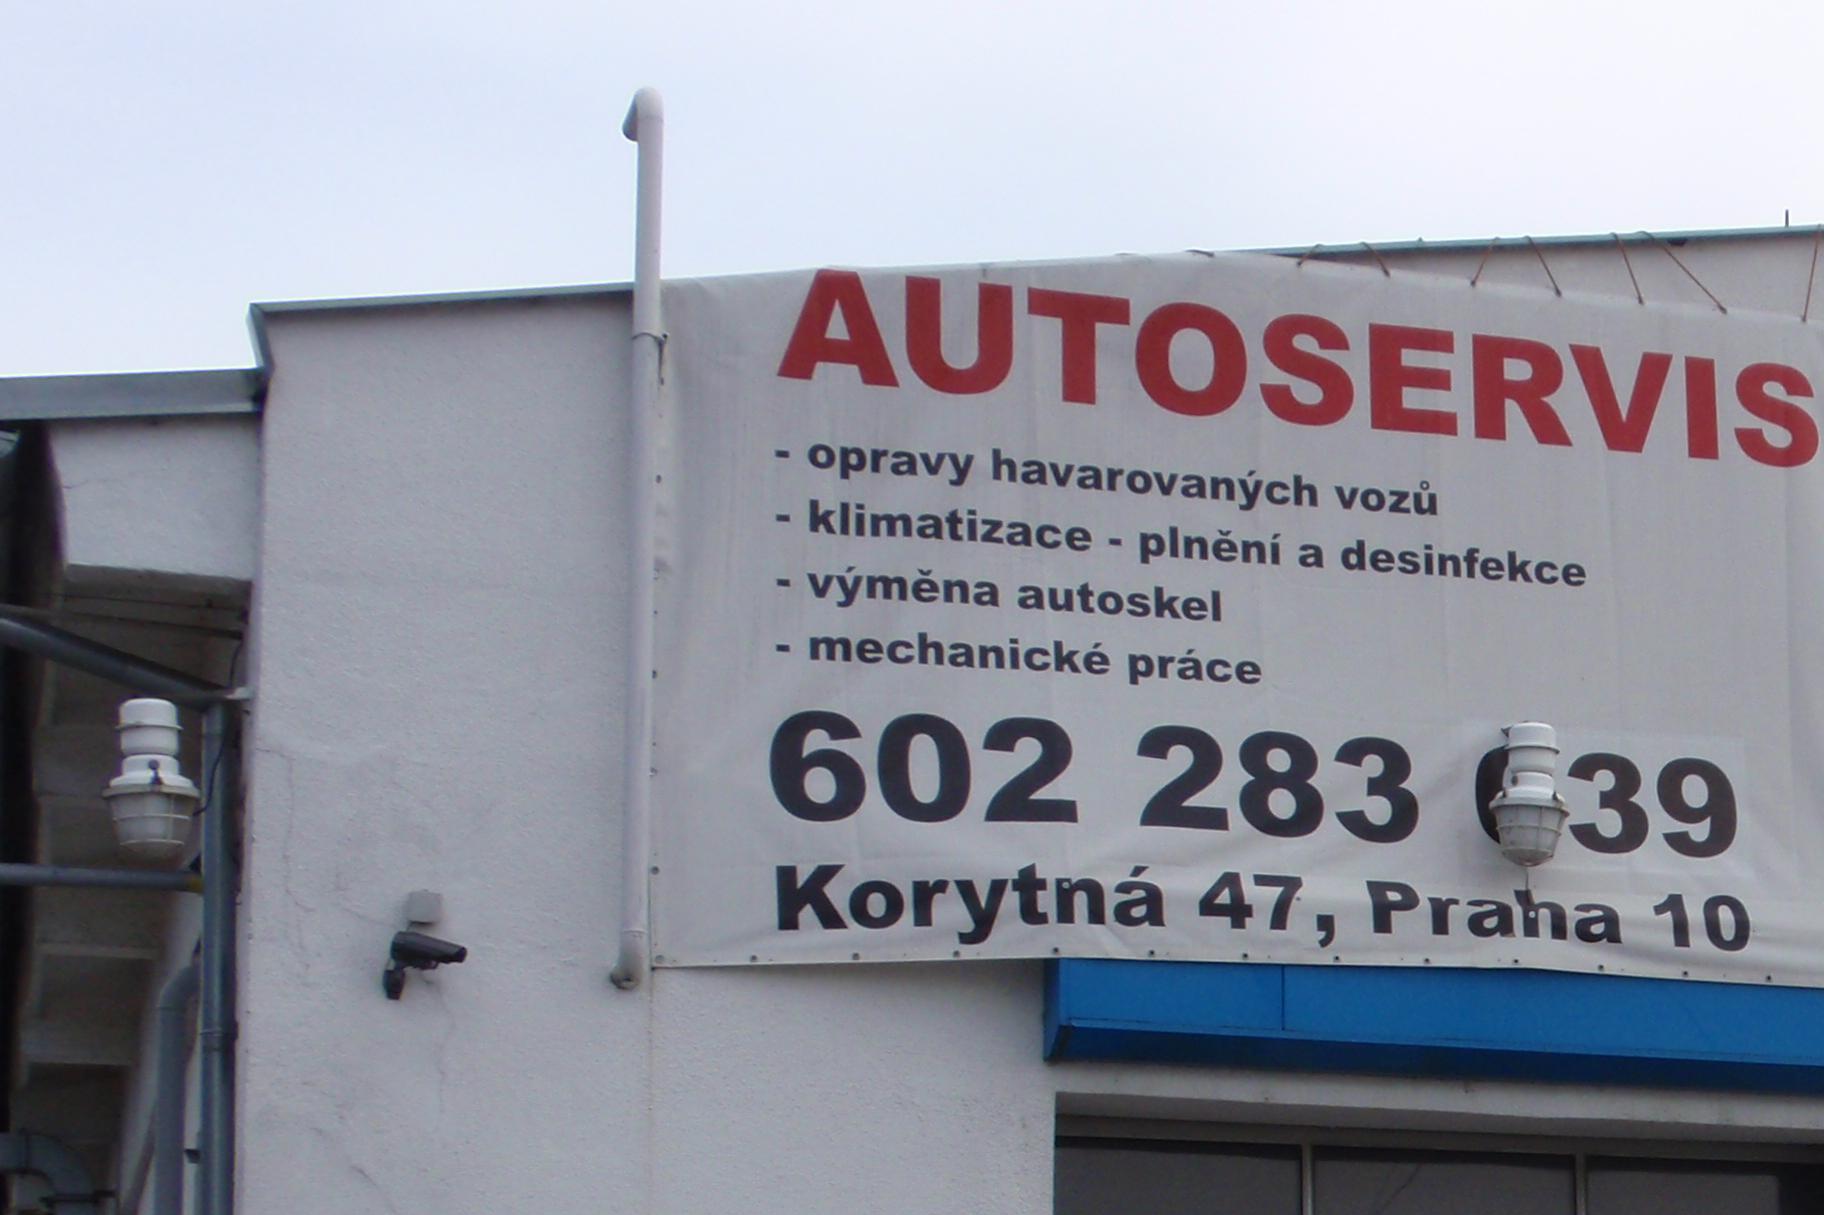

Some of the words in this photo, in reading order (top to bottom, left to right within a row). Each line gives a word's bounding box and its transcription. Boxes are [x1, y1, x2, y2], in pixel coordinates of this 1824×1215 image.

[777, 268, 1819, 468] AUTOSERVIS
[808, 444, 973, 486] opravy
[992, 448, 1317, 511] havarovaných
[1335, 481, 1437, 515] vozů
[810, 500, 1091, 551] klimatizace
[1140, 527, 1280, 565] plnění
[1299, 544, 1323, 568] a
[1341, 540, 1586, 586] desinfekce
[808, 567, 999, 607] výměna
[1018, 585, 1221, 621] autoskel
[810, 633, 1110, 674] mechanické
[1129, 649, 1261, 685] práce
[770, 711, 1077, 823] 602
[1138, 726, 1418, 843] 283
[1475, 744, 1738, 858] 39
[776, 864, 1165, 945] Korytná
[1199, 872, 1335, 948] 47,
[1366, 879, 1623, 944] Praha
[1654, 894, 1750, 951] 10
